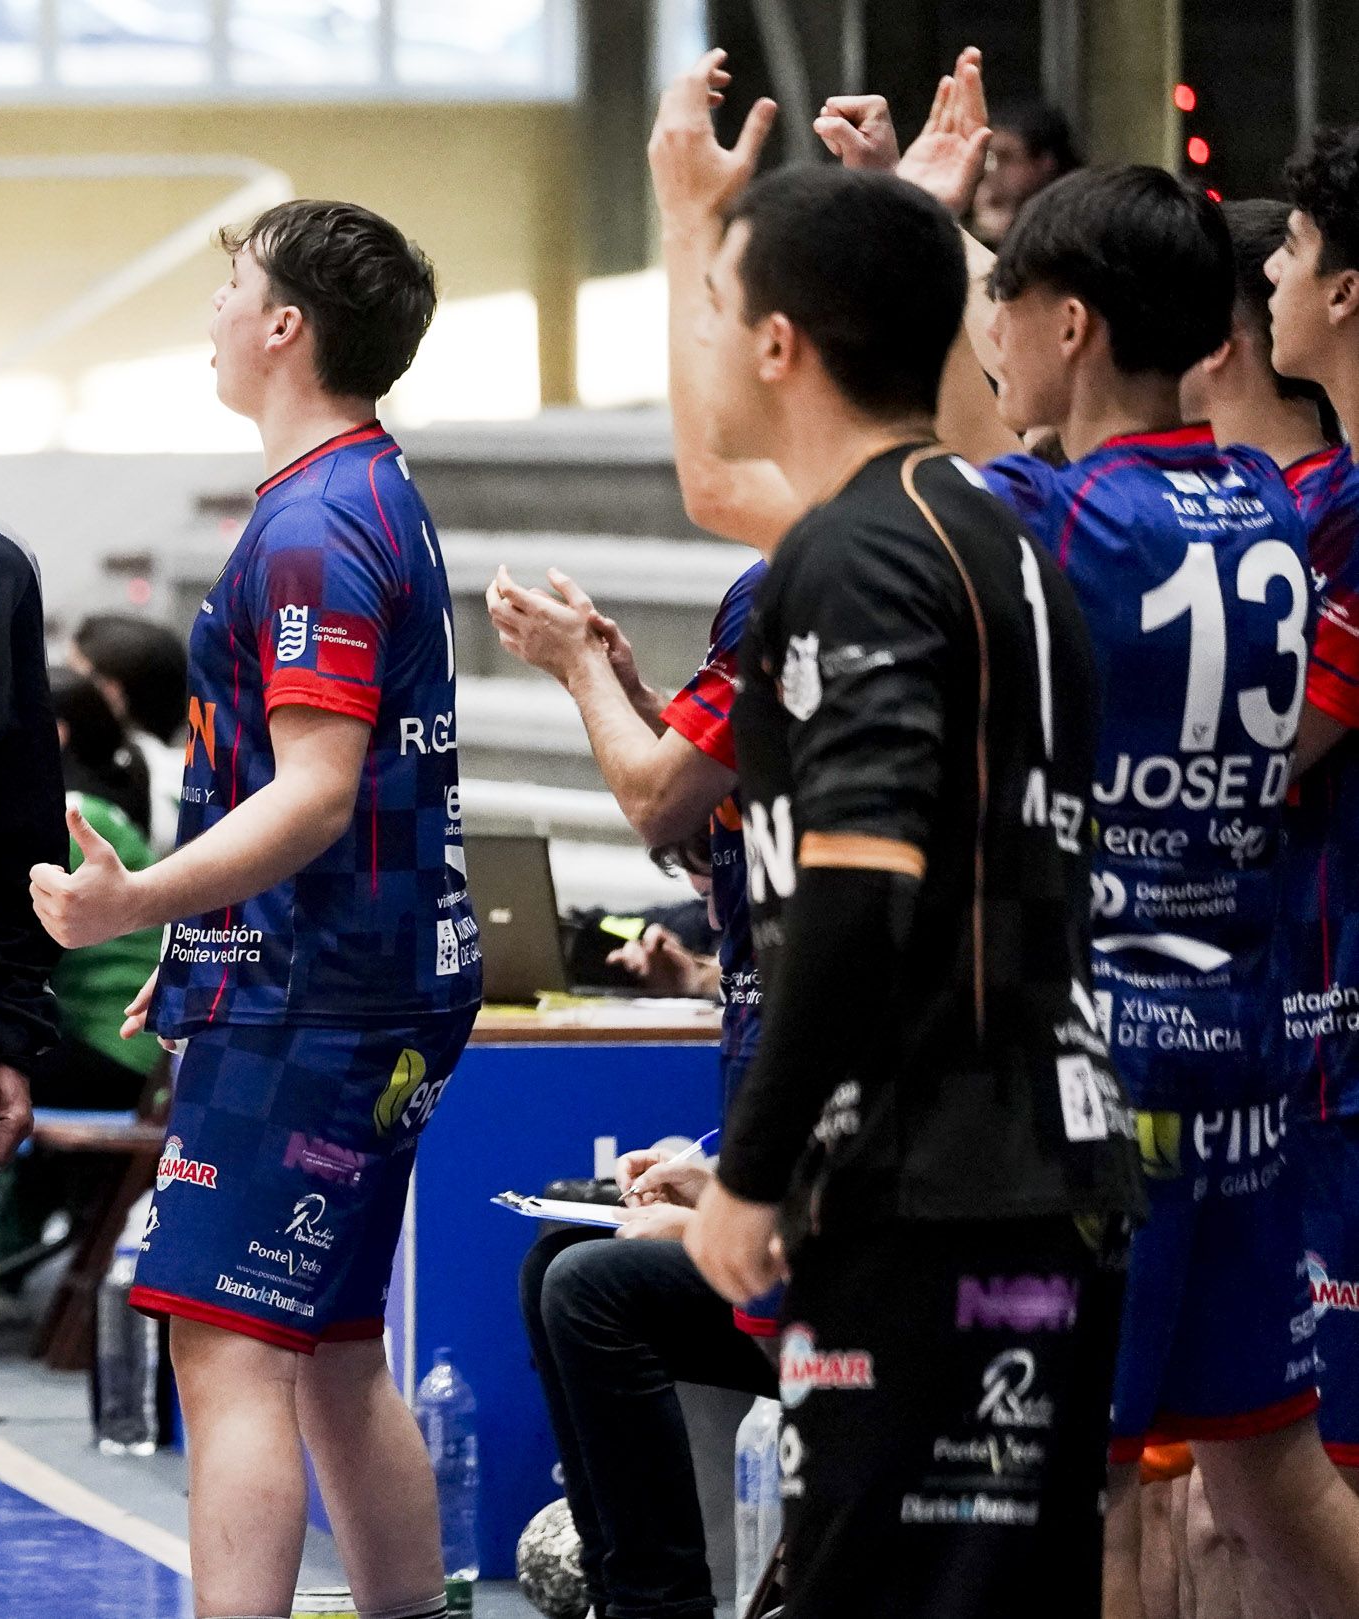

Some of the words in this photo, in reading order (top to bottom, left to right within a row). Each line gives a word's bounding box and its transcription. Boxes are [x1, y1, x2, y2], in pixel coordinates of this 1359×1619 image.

[311, 634, 323, 642] de
[323, 635, 368, 650] Pontevedra
[313, 624, 347, 636] Concello
[1141, 537, 1309, 752] 13
[1091, 752, 1253, 812] JOSE
[1103, 823, 1191, 859] ence
[175, 923, 263, 948] Deputación
[170, 944, 261, 964] Pontevedra
[1121, 998, 1198, 1028] XUNTA
[1117, 1022, 1150, 1049] DE
[1157, 1025, 1243, 1053] GALICIA
[248, 1241, 322, 1277] PonteVedra
